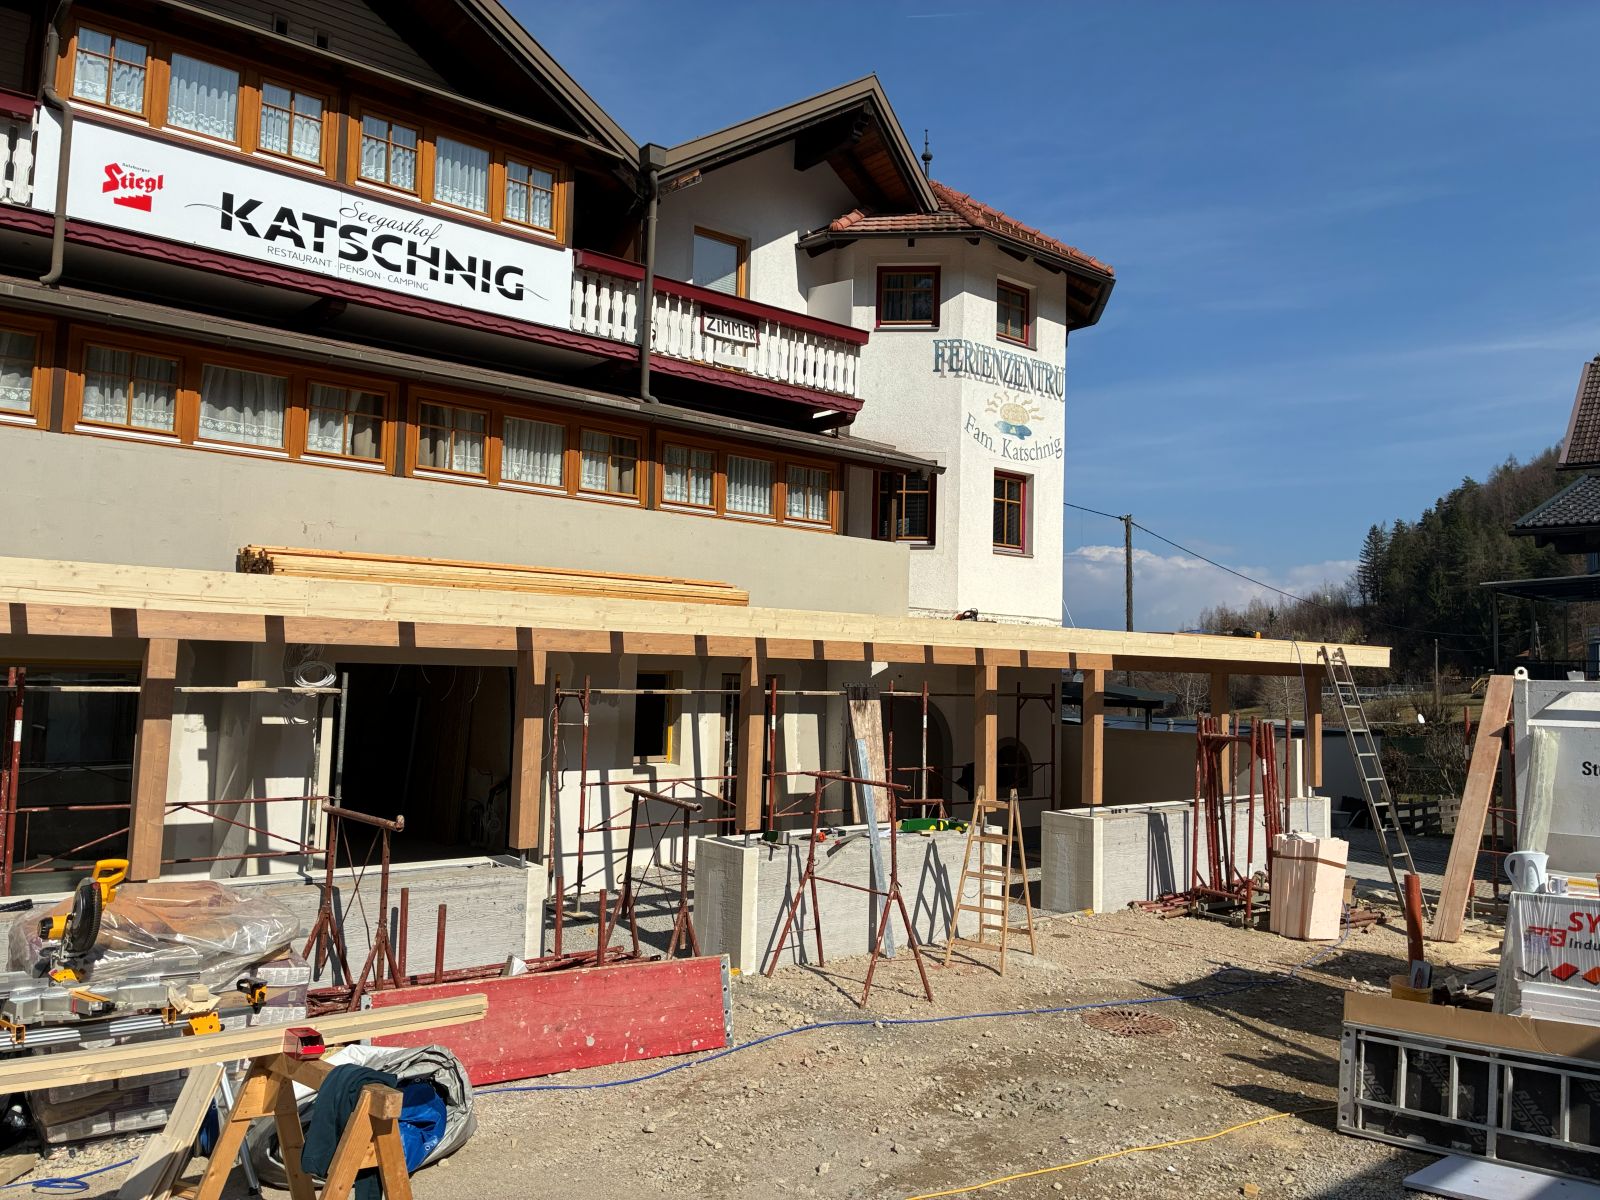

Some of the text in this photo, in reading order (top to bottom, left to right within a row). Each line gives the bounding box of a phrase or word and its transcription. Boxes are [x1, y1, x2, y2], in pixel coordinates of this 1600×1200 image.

[102, 162, 164, 193] Stiegl
[220, 191, 524, 301] KATSCHNIG
[339, 201, 443, 246] Seegasthof
[267, 245, 430, 292] RESTAURANT PENSION CAMPING
[964, 412, 1063, 462] Fam. Katschnig
[1581, 760, 1600, 777] St
